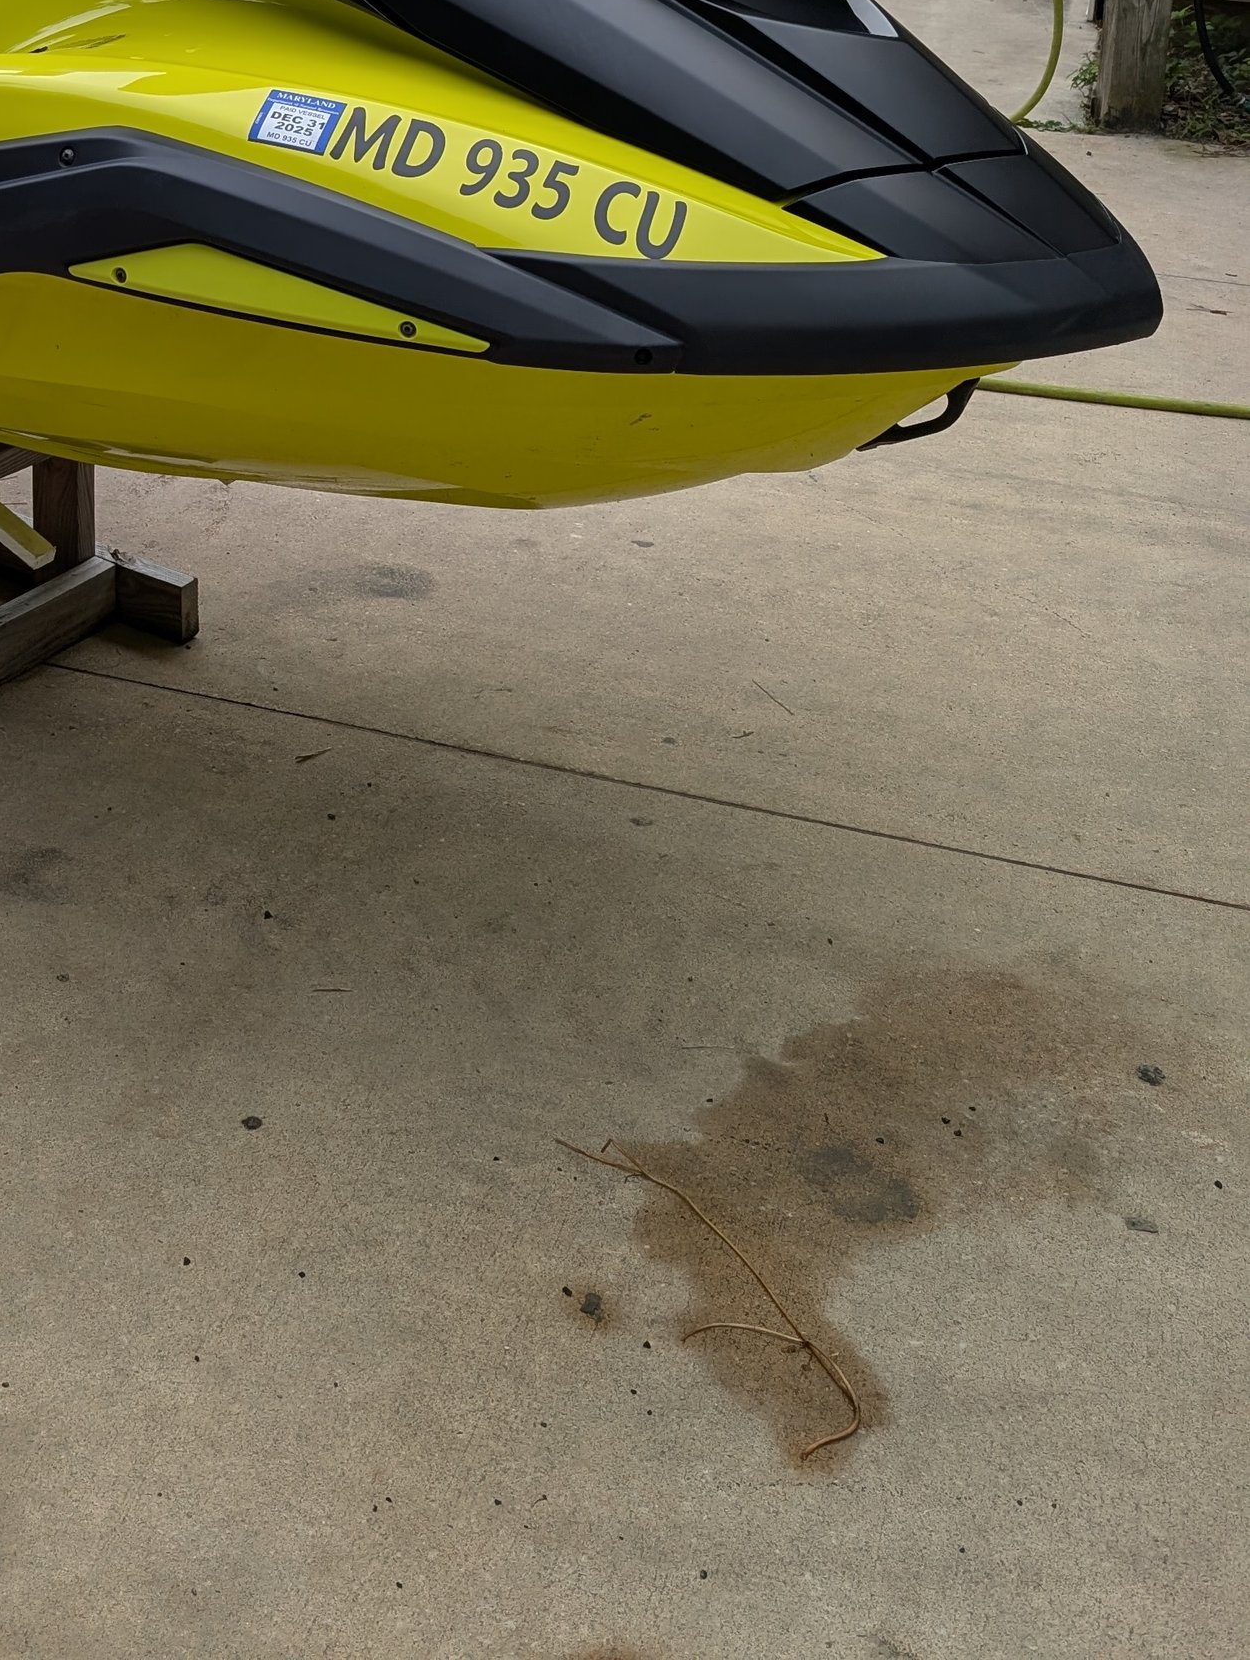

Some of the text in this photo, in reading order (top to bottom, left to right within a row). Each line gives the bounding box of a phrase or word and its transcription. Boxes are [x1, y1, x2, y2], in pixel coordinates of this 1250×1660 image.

[276, 92, 336, 109] MARYLAND
[270, 111, 303, 125] DEC
[307, 119, 326, 130] 31
[279, 105, 326, 120] PAID VESSEL
[274, 121, 313, 137] 2025
[266, 131, 312, 147] MD 935 CU
[329, 106, 688, 260] MD 935 CU
